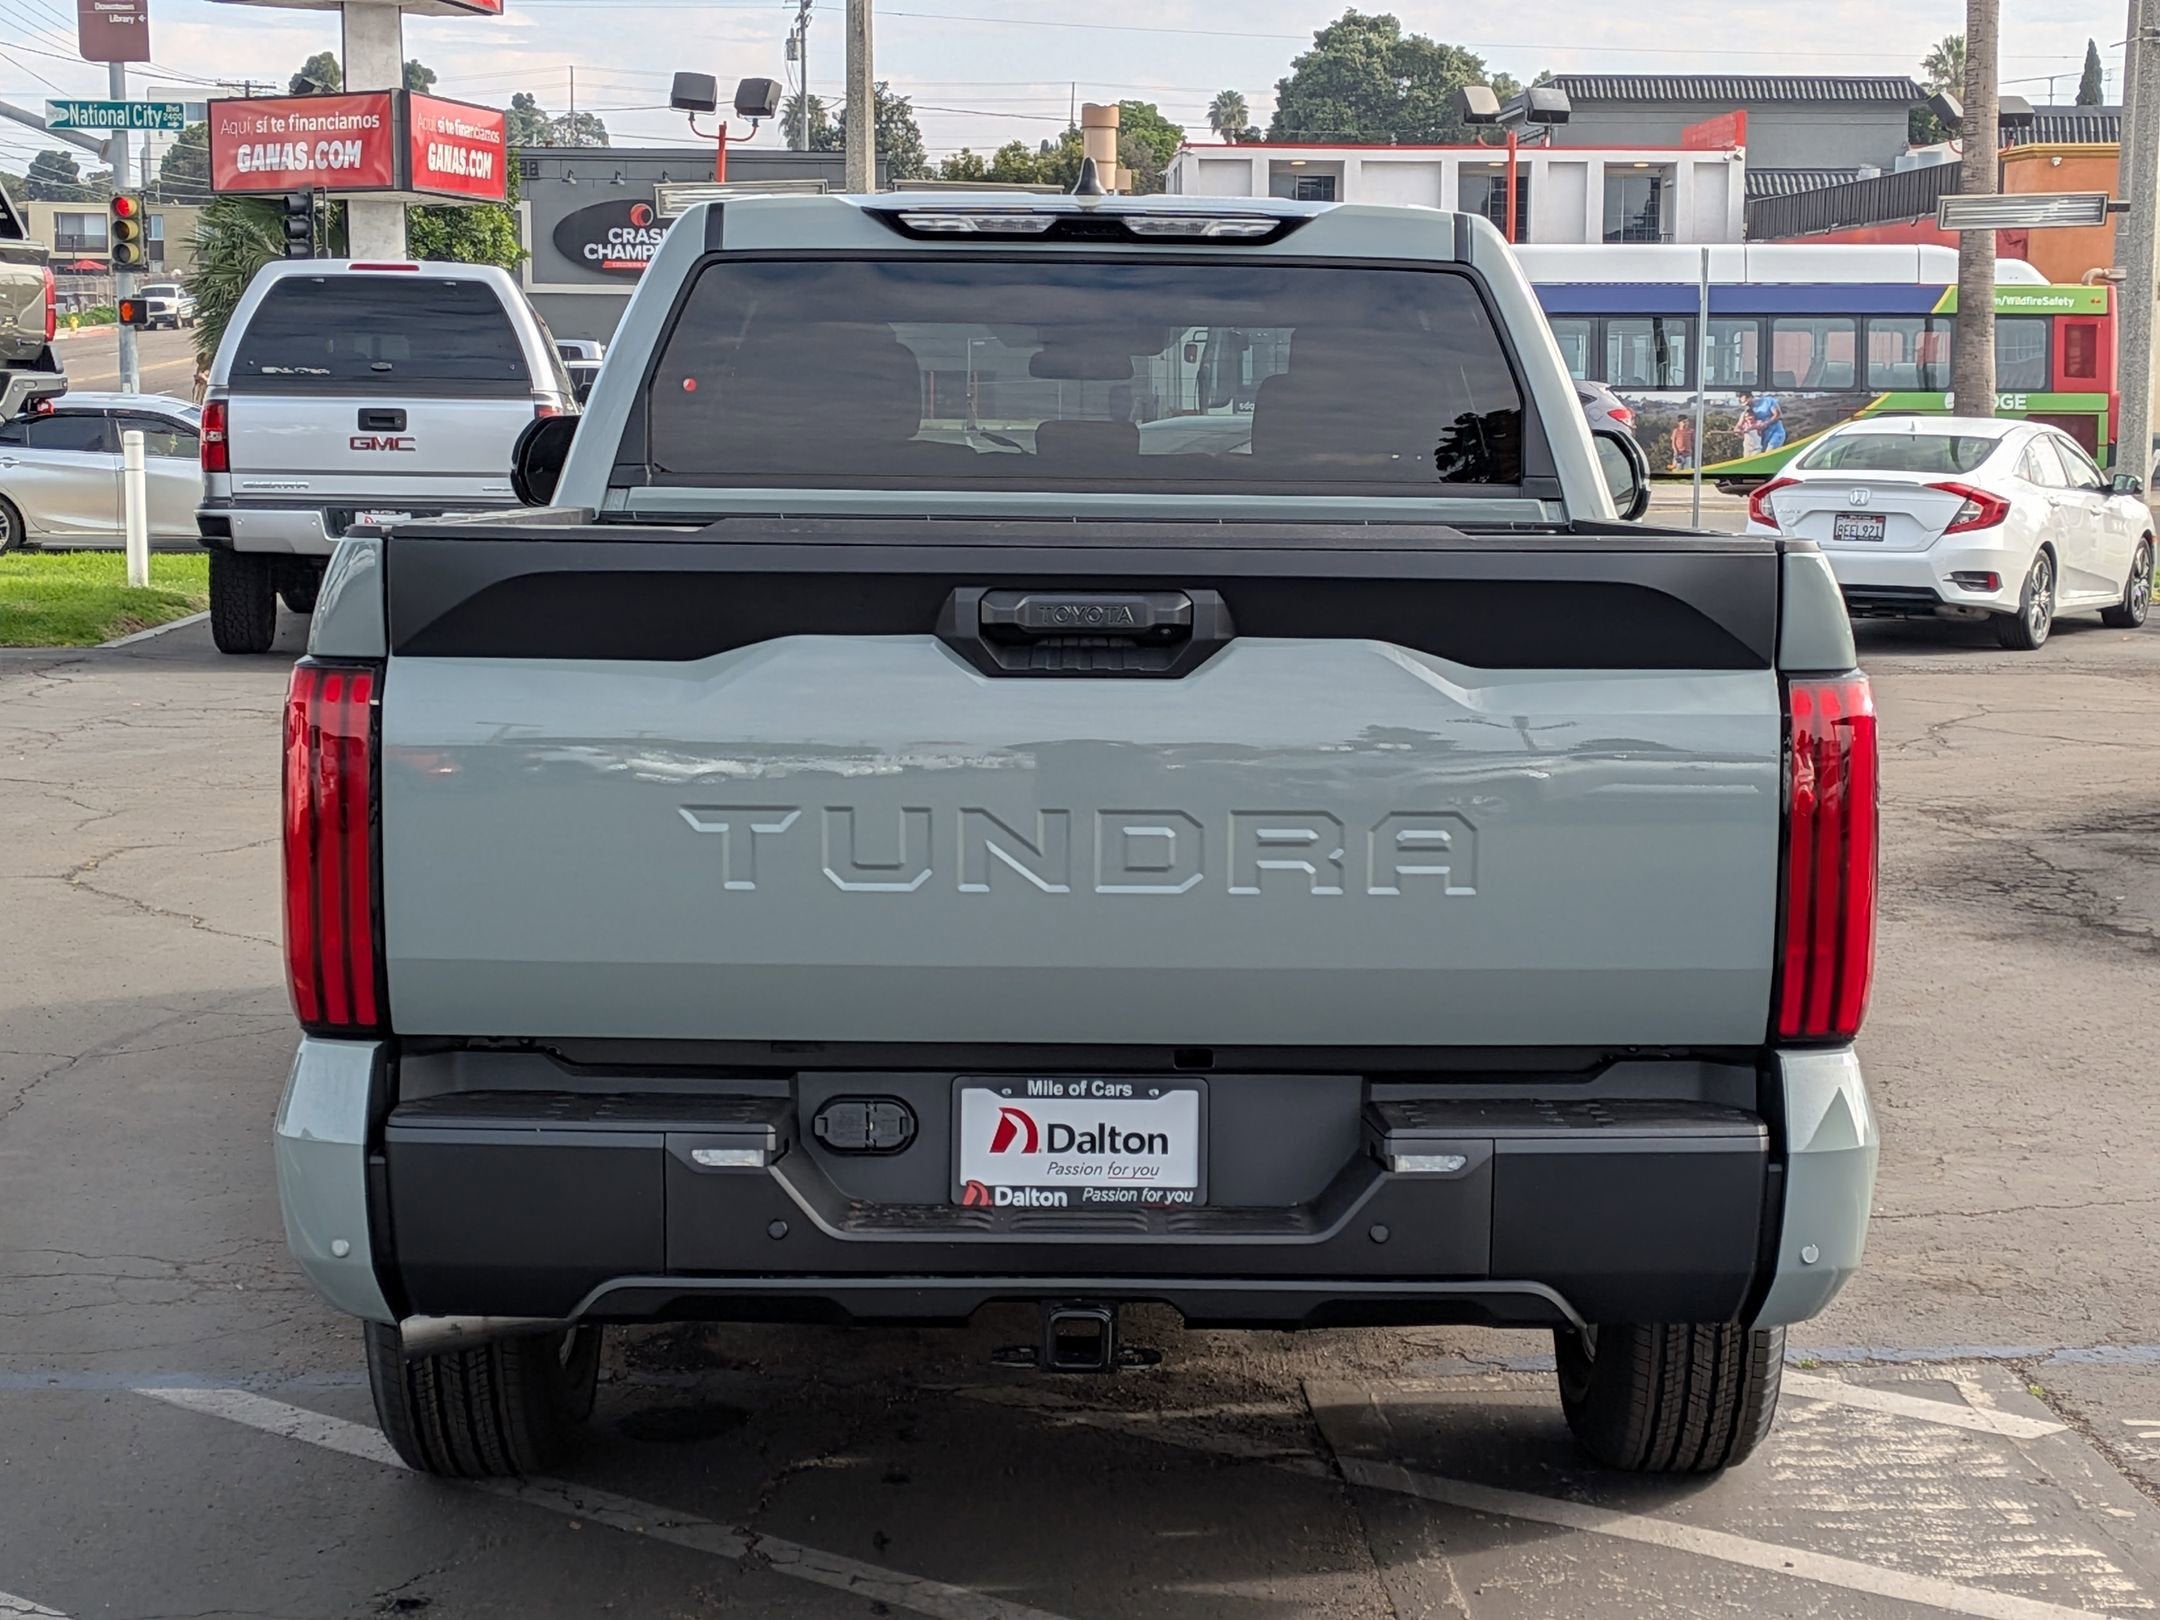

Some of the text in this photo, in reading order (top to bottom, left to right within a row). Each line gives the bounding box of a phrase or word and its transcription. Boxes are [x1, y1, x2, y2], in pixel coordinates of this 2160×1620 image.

[108, 14, 134, 24] Library
[68, 103, 180, 128] National City Blvd
[163, 113, 182, 121] 2400
[255, 114, 268, 134] sí
[270, 117, 286, 133] te
[288, 111, 380, 132] financiamos
[454, 118, 500, 144] financiamos
[237, 140, 362, 173] GANAS.COM
[427, 142, 492, 180] GANAS.COM
[350, 436, 417, 452] GMC
[1038, 605, 1135, 624] TOYOTA
[679, 804, 1479, 896] TUNDRA
[1027, 1080, 1133, 1097] Mile of Cars
[1047, 1123, 1169, 1155] Dalton
[1047, 1161, 1160, 1178] Passion for you
[994, 1187, 1194, 1207] Dalton Passion for you
